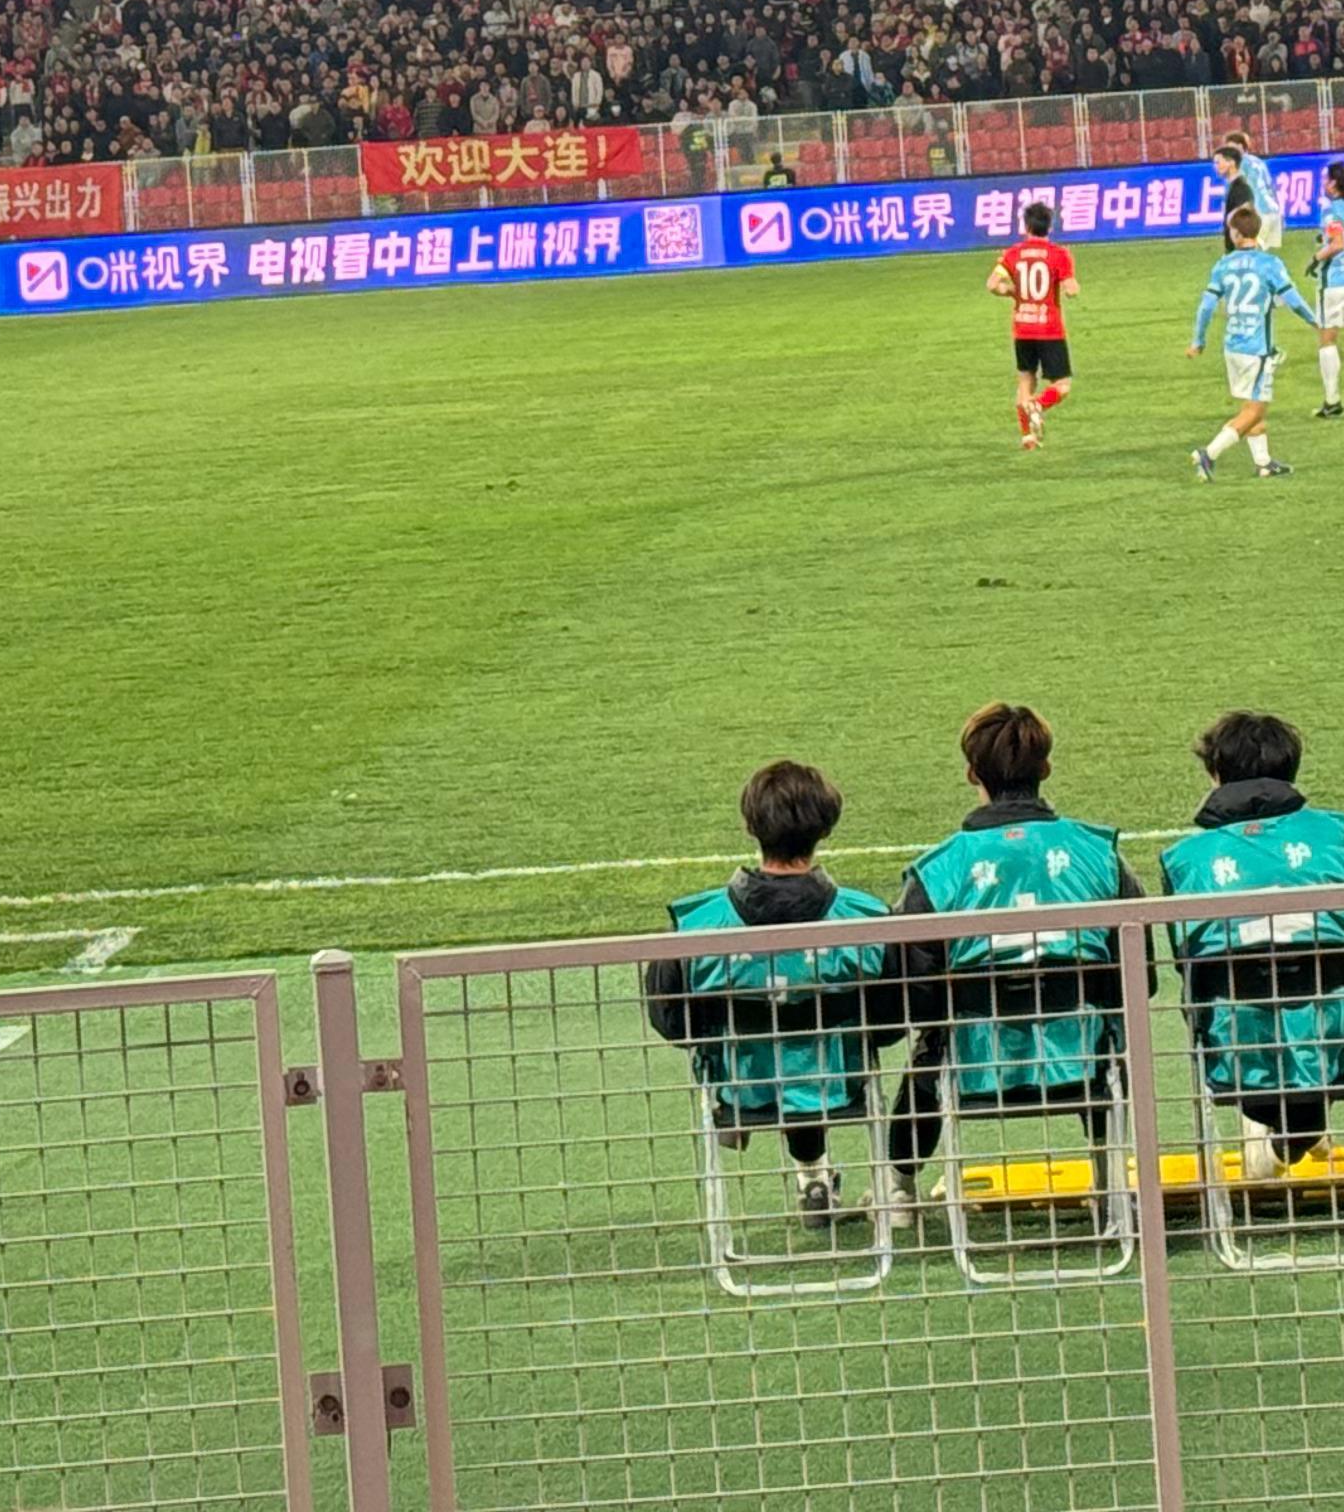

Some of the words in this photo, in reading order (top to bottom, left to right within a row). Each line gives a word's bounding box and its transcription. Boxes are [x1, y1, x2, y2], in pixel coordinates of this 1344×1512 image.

[247, 216, 622, 286] 电视看中超上咪视界
[1015, 260, 1050, 301] 10
[1222, 272, 1261, 315] 22
